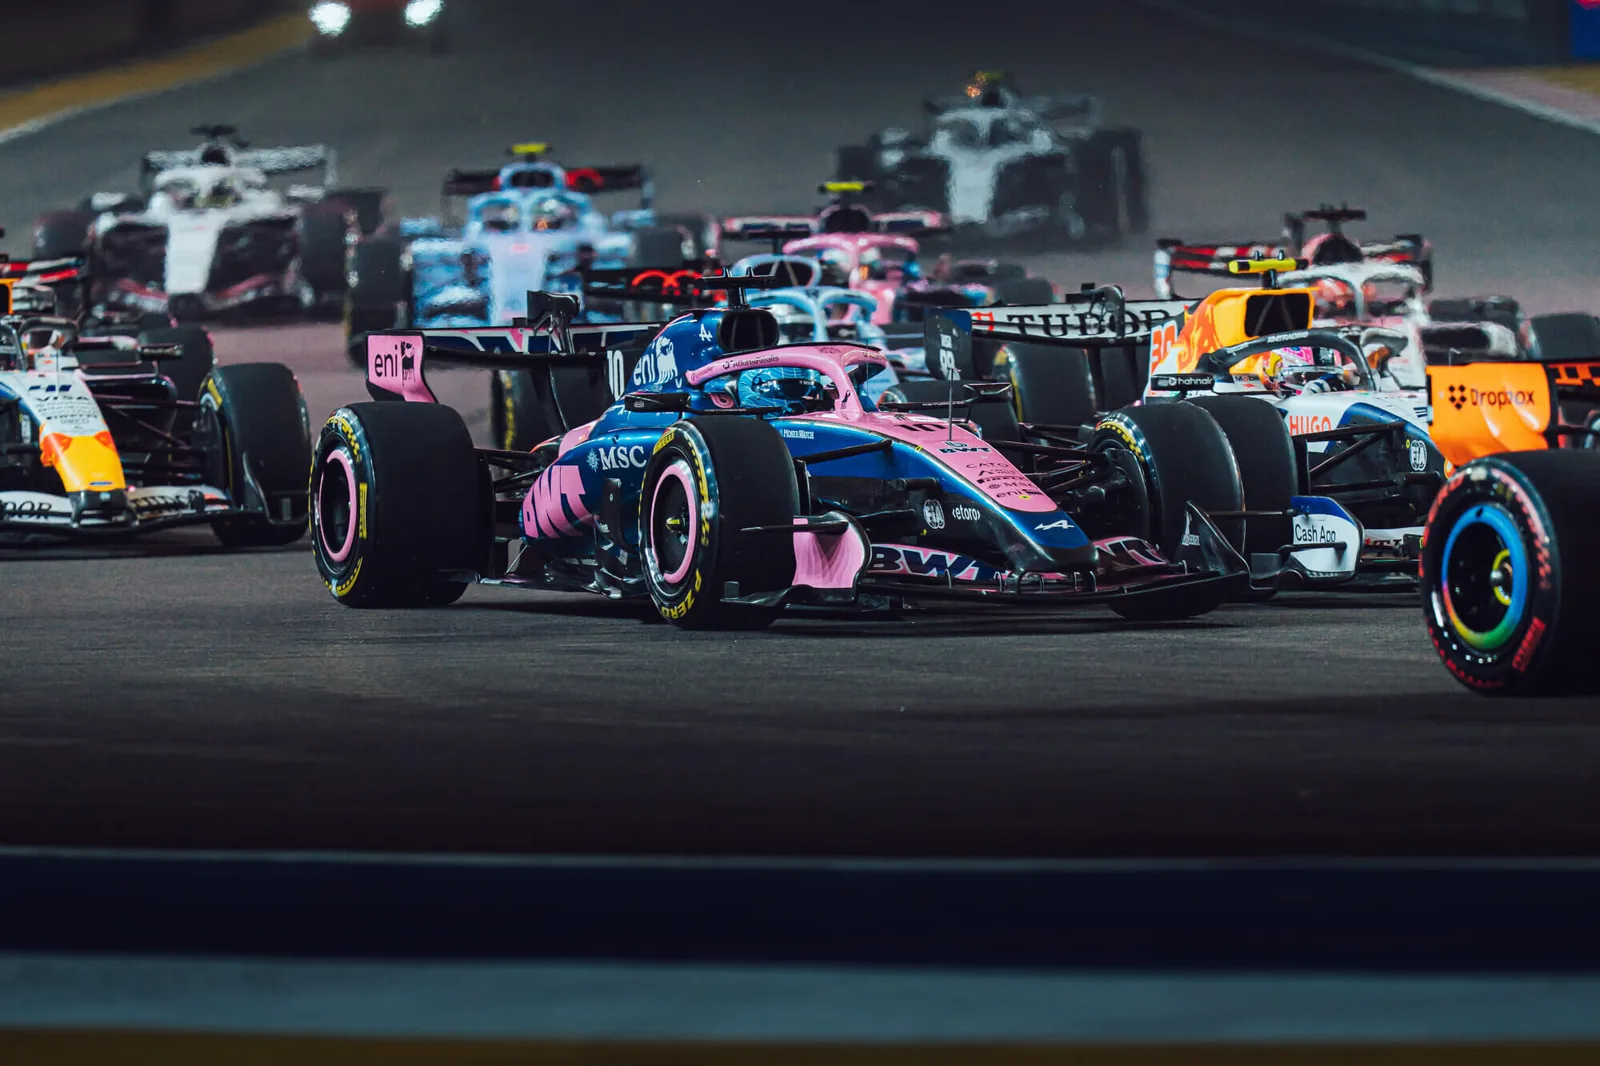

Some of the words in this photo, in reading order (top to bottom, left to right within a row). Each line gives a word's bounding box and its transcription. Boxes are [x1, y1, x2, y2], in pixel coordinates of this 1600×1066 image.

[374, 344, 398, 378] eni
[633, 353, 655, 386] eni
[607, 349, 625, 402] 10
[1177, 376, 1214, 386] hahnair
[1470, 386, 1535, 410] Dropbox
[1289, 415, 1332, 436] HUGO
[598, 445, 647, 470] MSC
[1295, 523, 1318, 542] Cash
[661, 588, 695, 619] ZERO
